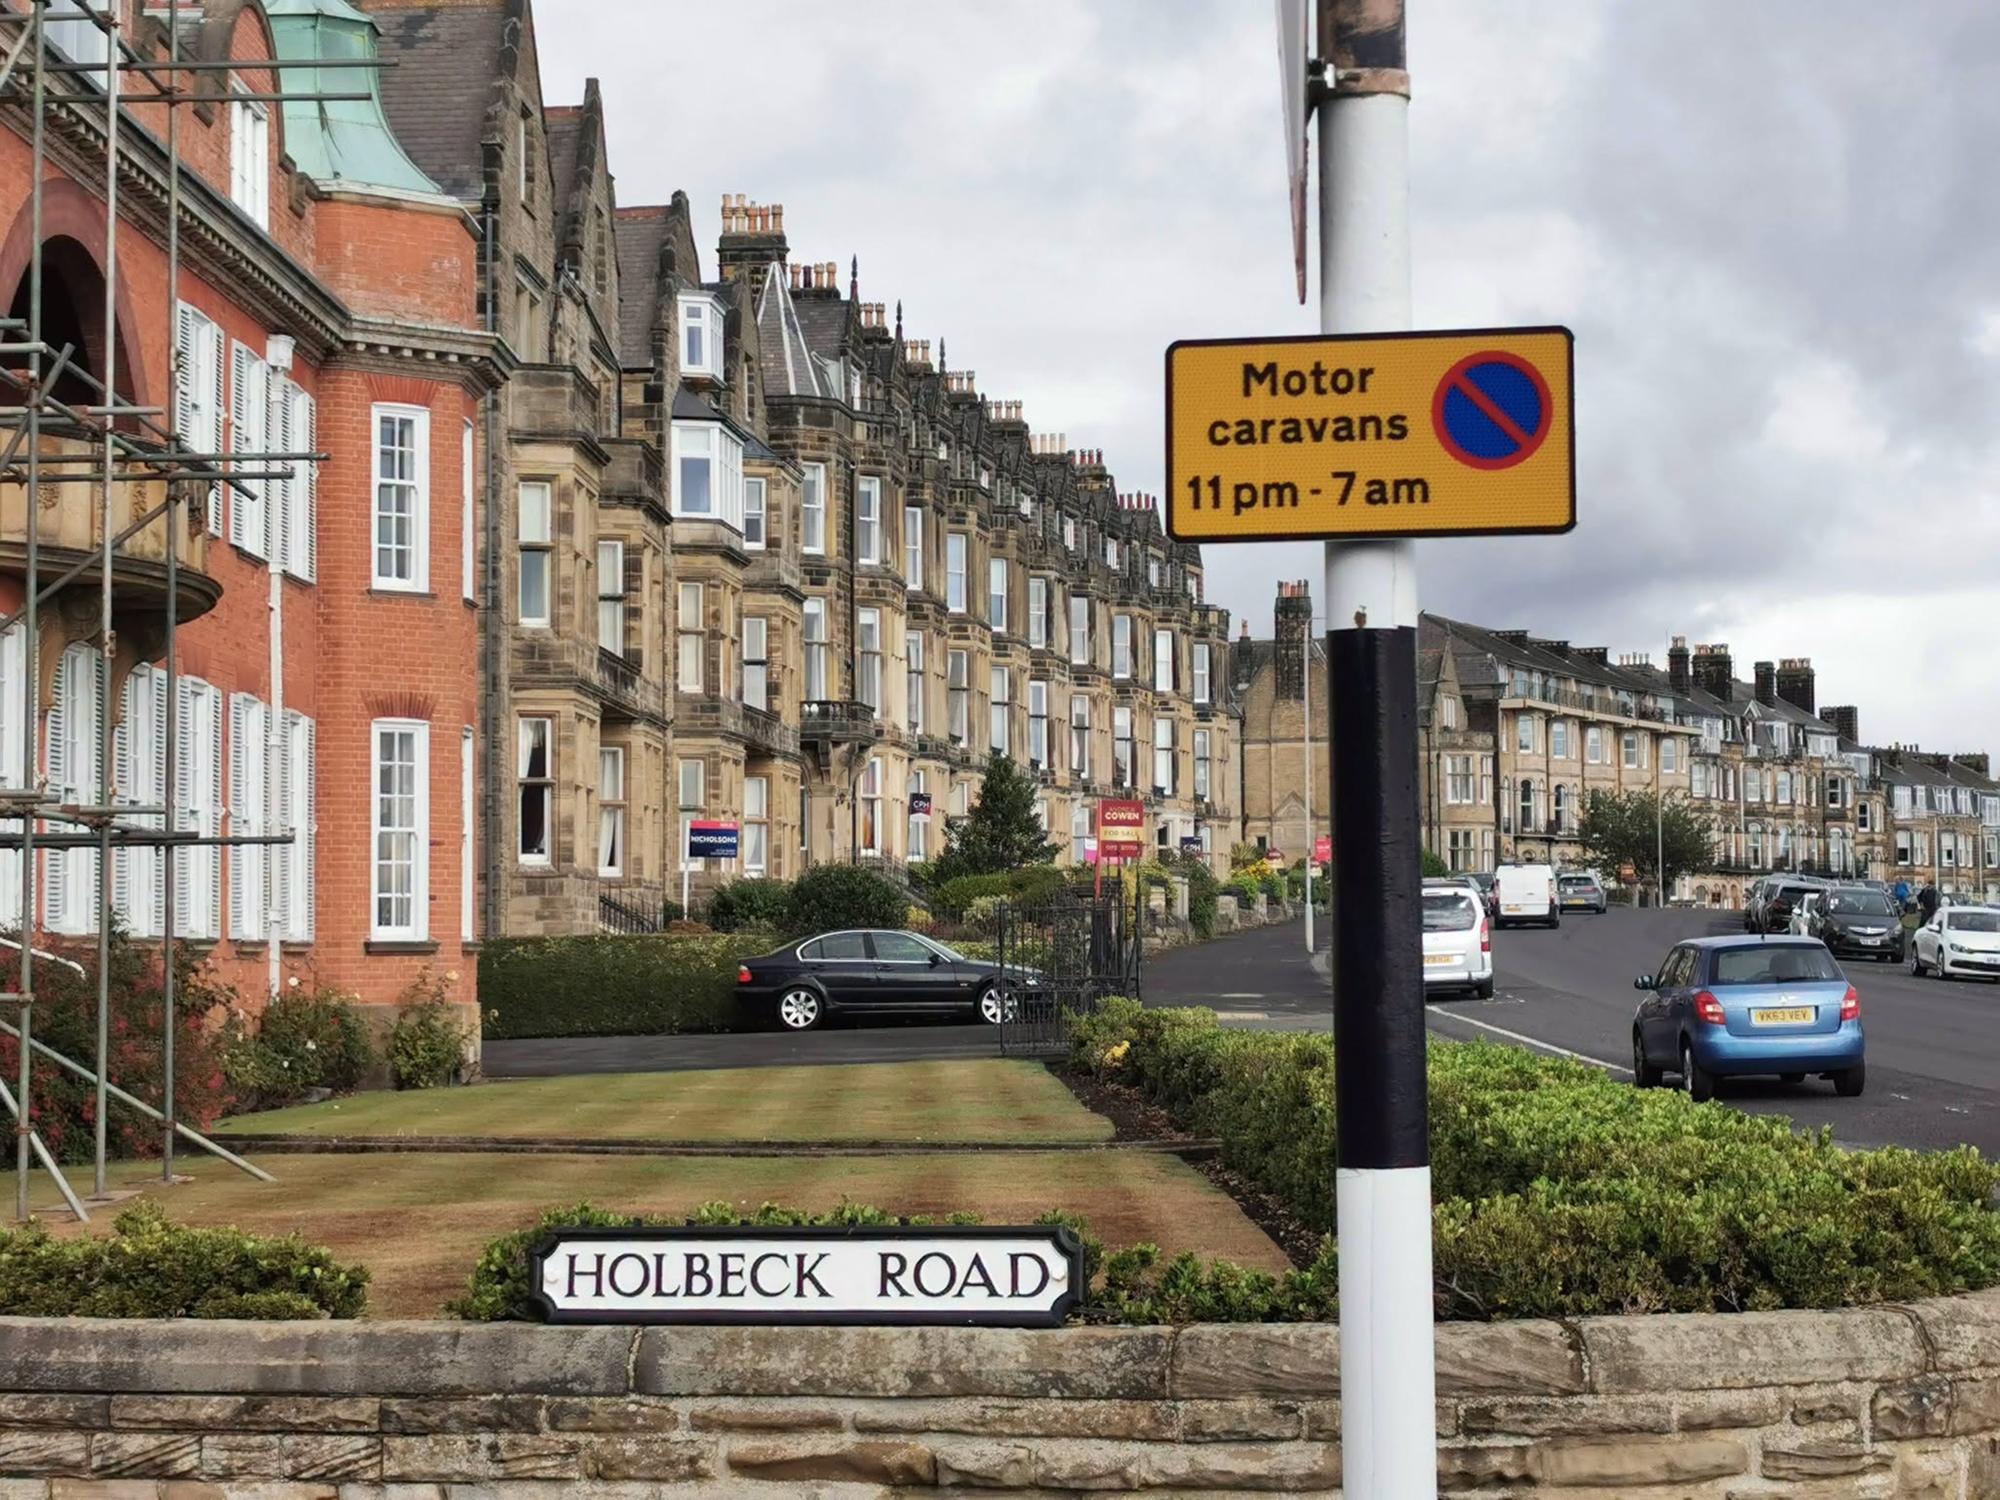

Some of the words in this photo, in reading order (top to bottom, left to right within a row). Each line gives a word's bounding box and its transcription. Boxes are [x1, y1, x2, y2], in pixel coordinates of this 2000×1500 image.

[1241, 361, 1374, 397] Motor
[1208, 413, 1409, 446] caravans
[1104, 811, 1140, 820] COWEN
[690, 836, 738, 844] NICHOLSONS
[564, 1252, 834, 1299] HOLBECK
[877, 1252, 1051, 1299] ROAD
